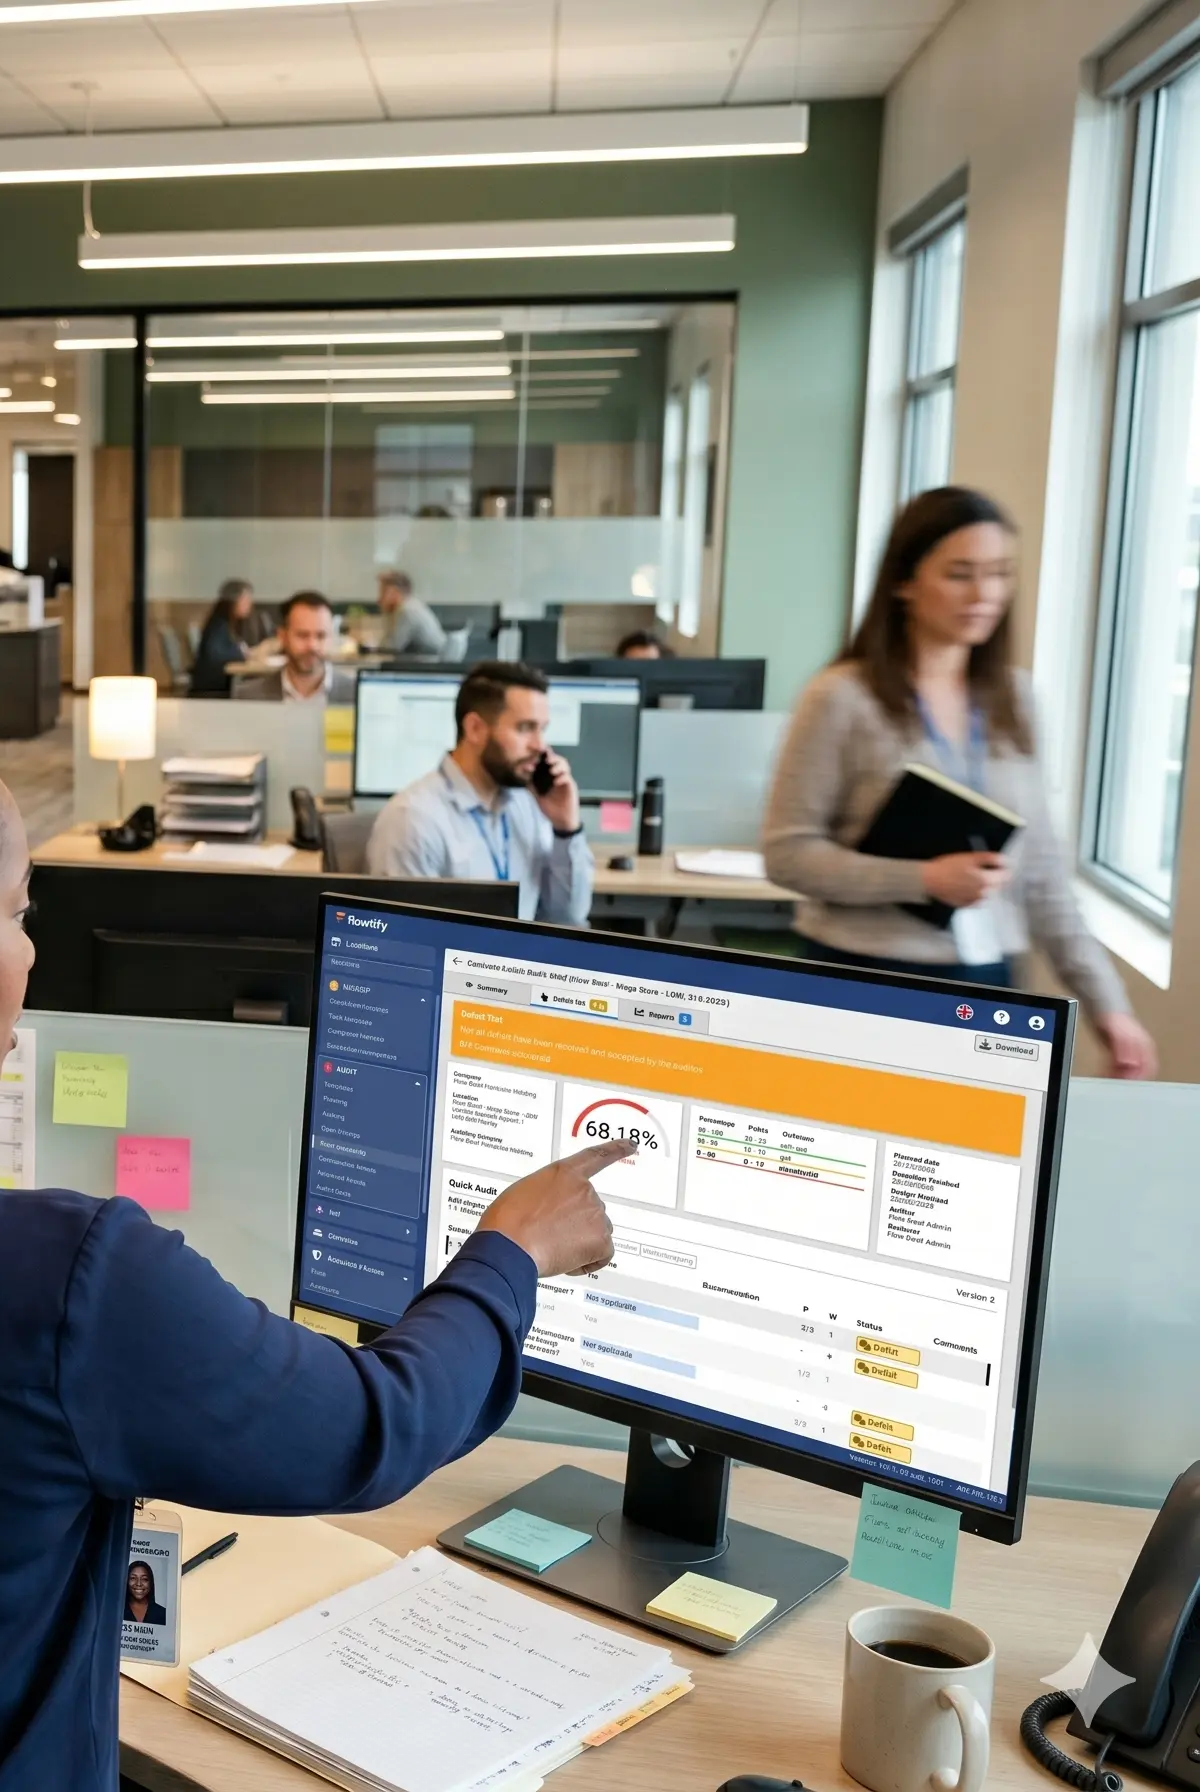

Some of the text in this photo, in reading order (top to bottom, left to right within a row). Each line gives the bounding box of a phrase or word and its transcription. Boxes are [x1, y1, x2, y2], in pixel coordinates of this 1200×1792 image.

[477, 983, 508, 996] Summary
[639, 986, 659, 996] Store
[336, 1066, 358, 1076] AUDIT
[586, 1120, 658, 1150] 68.18%
[924, 1158, 940, 1167] date
[449, 1178, 498, 1196] Quick Audit
[956, 1288, 996, 1304] Version 2
[829, 1313, 838, 1321] W
[856, 1319, 883, 1332] Status
